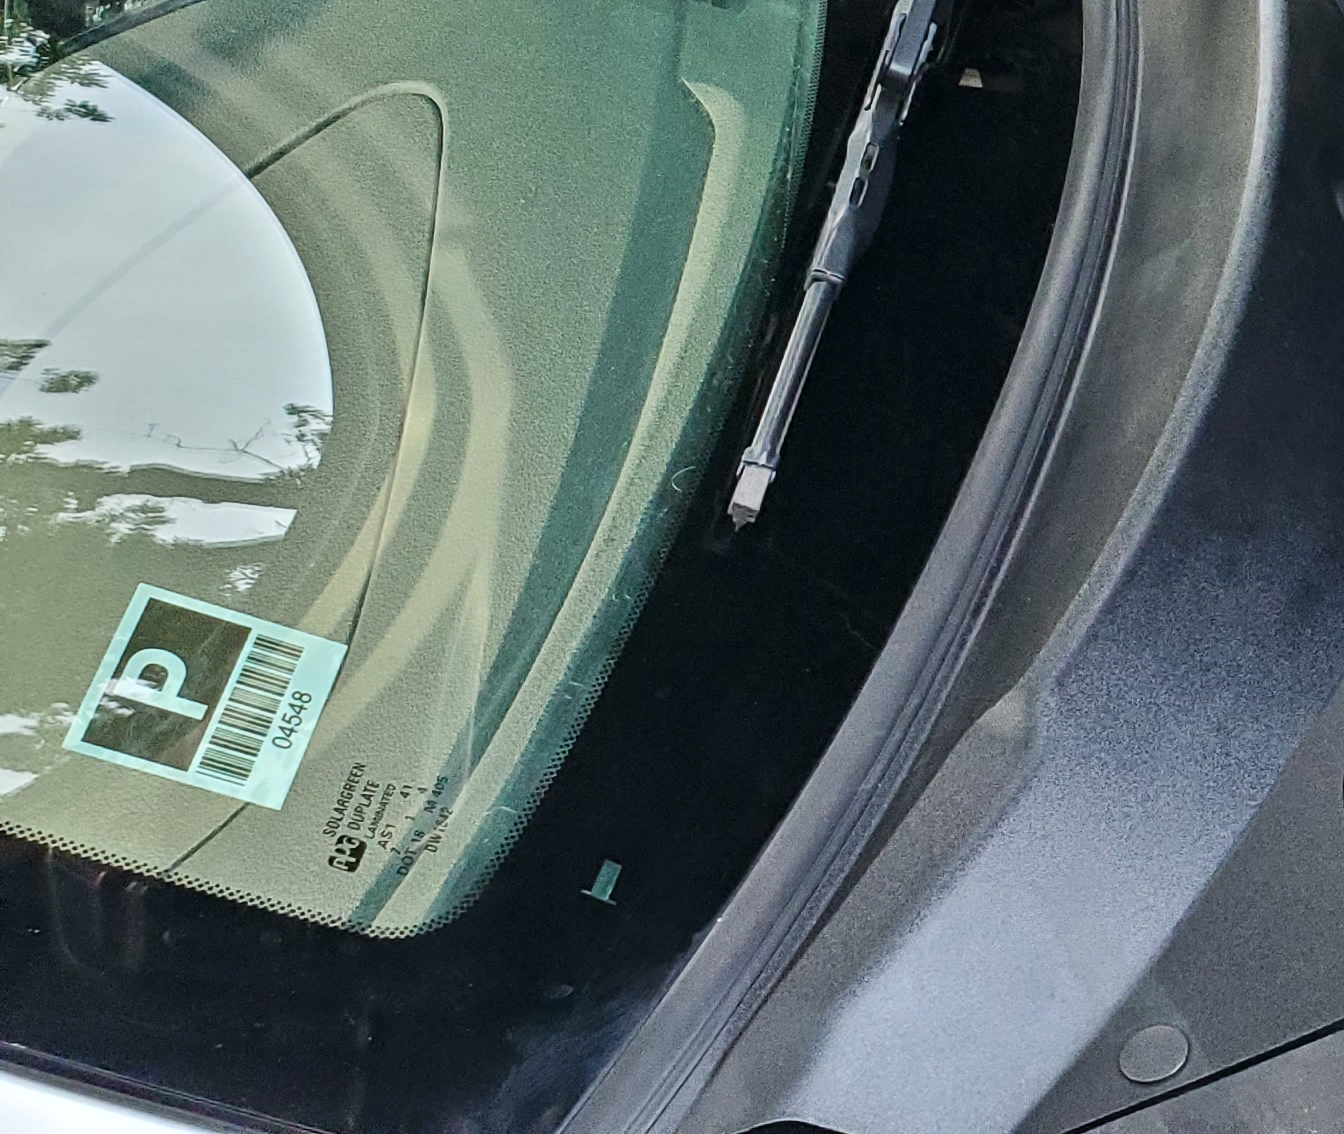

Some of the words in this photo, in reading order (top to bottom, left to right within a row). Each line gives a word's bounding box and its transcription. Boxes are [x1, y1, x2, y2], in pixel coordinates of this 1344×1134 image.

[113, 648, 209, 721] P
[271, 689, 313, 750] 04548
[323, 762, 366, 837] SOLARGREEN
[347, 779, 380, 831] DUPLATE
[364, 783, 397, 840] LAMINATED
[396, 846, 417, 876] DOT
